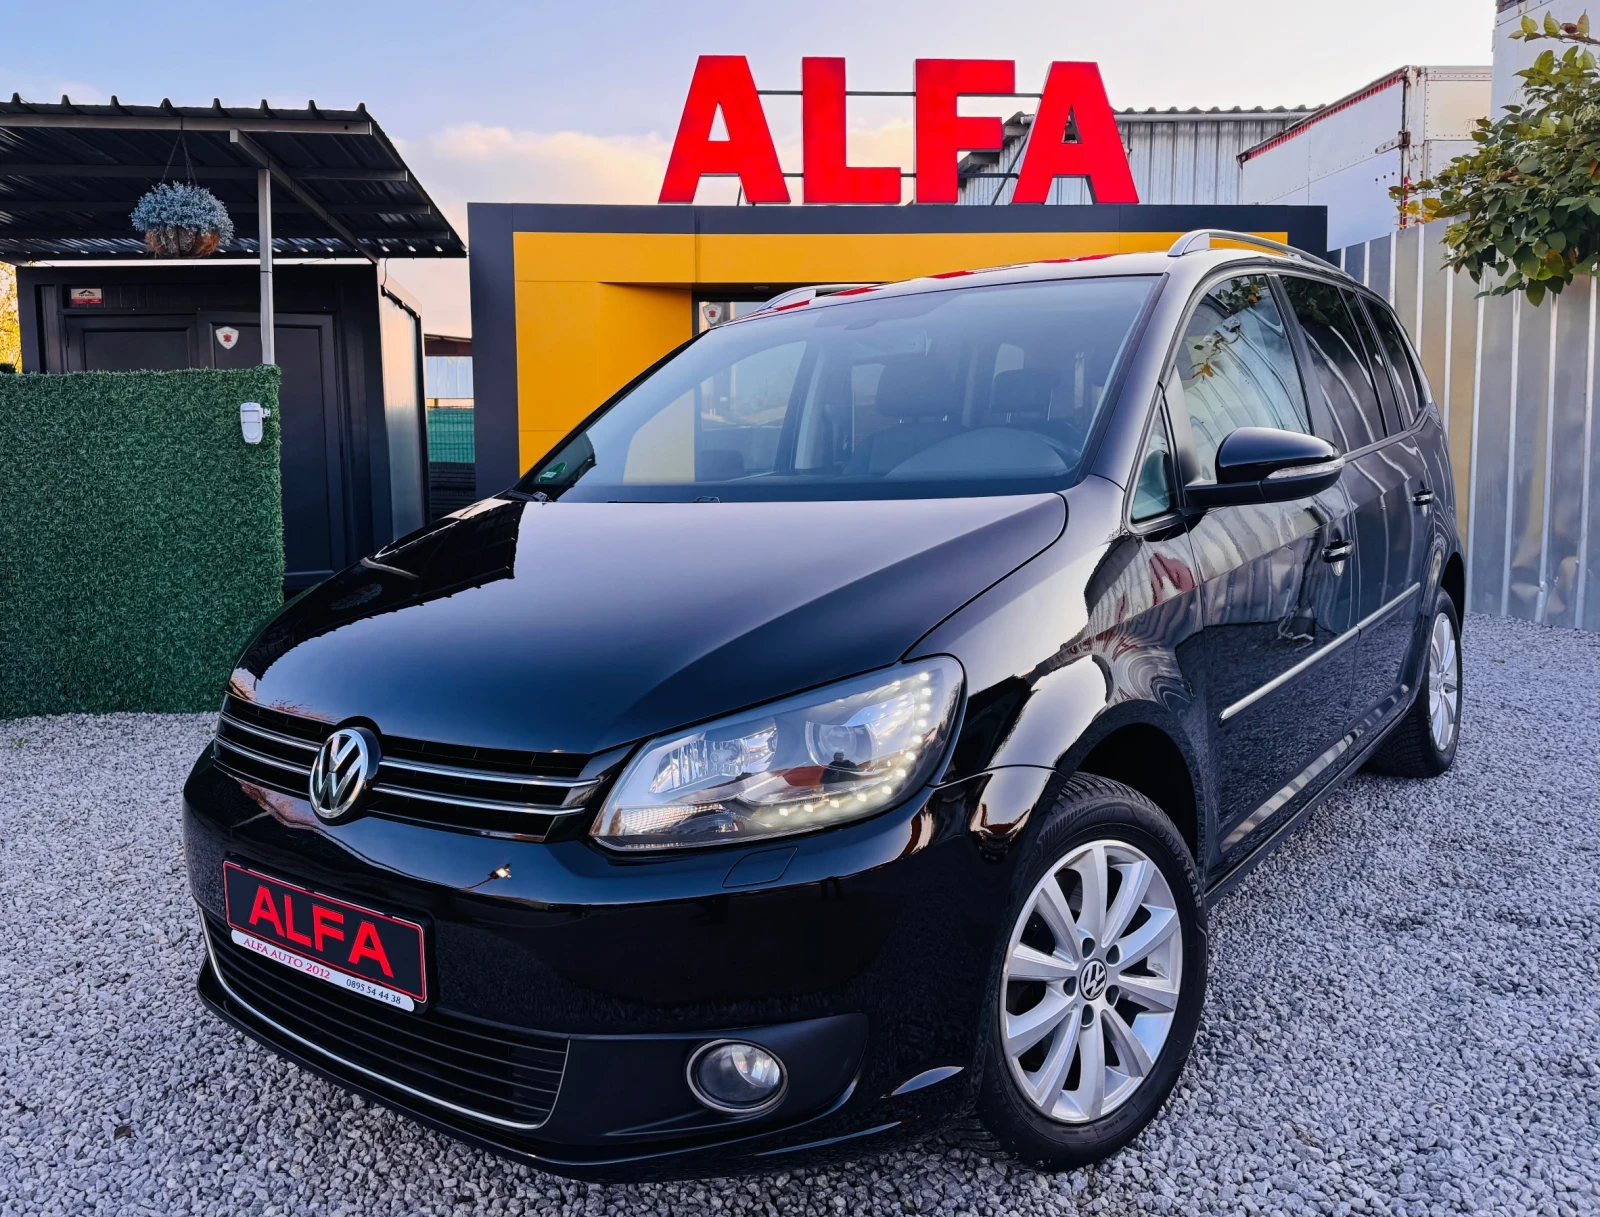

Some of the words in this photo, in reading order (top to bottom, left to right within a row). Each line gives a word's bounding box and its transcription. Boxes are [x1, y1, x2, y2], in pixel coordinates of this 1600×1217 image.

[658, 55, 1139, 204] ALFA
[243, 938, 268, 954] ALFA
[271, 948, 303, 968] AUTO
[305, 963, 330, 979] 2012
[346, 978, 365, 992] 0895
[366, 985, 377, 996] 54
[378, 989, 389, 1000] 44
[390, 993, 401, 1004] 38
[249, 885, 394, 978] ALFA
